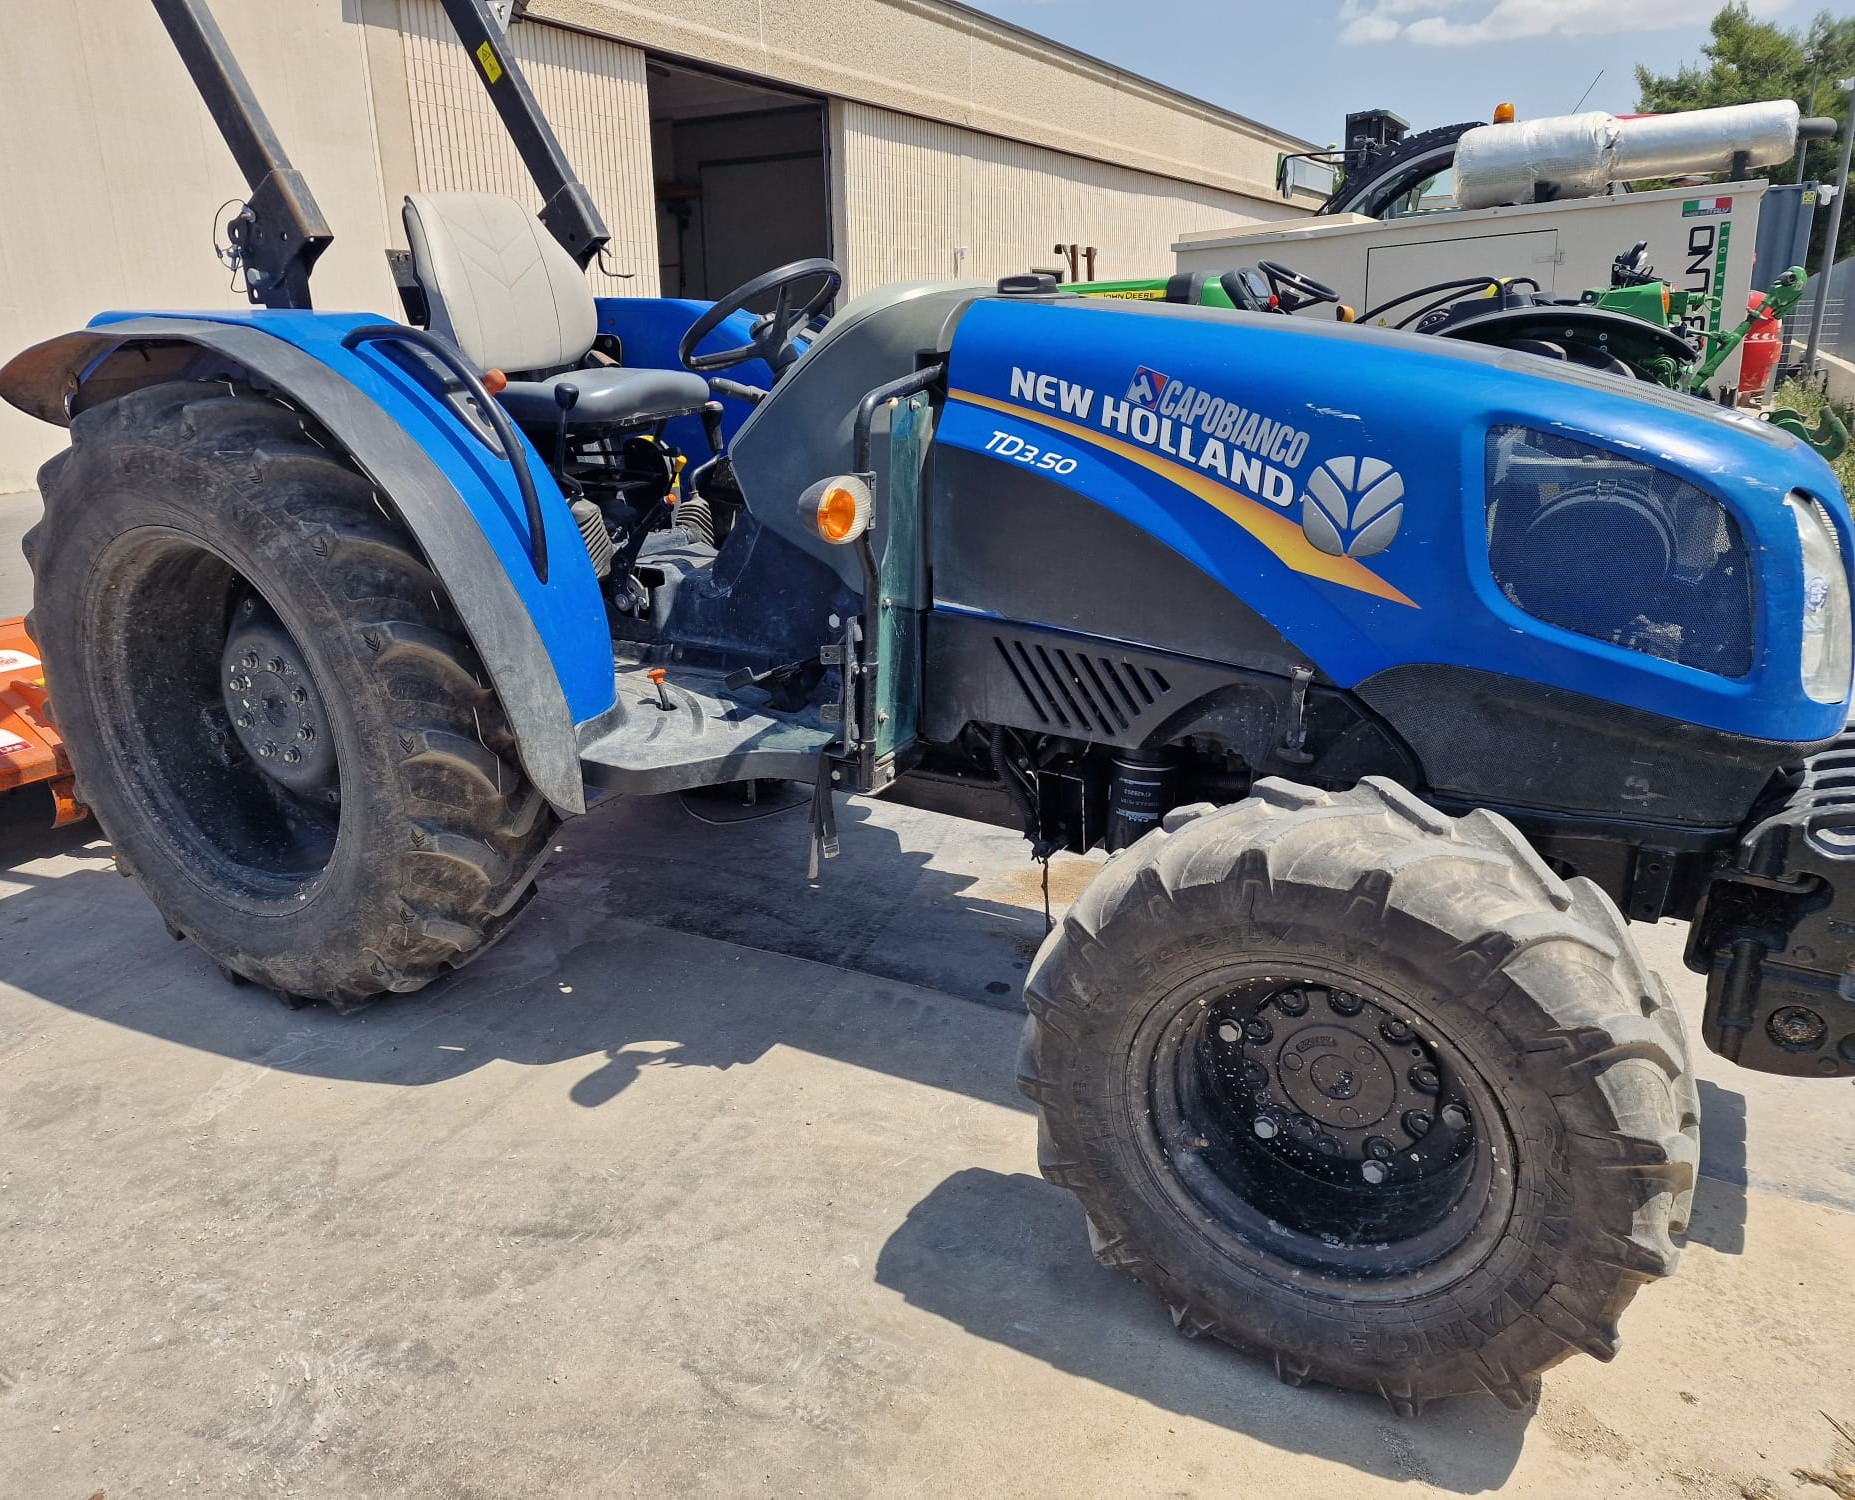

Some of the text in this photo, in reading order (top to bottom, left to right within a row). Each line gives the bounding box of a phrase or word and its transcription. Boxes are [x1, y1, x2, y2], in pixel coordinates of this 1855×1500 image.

[1125, 291, 1154, 300] DEERE
[984, 431, 1077, 475] TD3.50
[1009, 366, 1295, 508] NEW HOLLAND
[1159, 379, 1310, 469] CAPOBIANCO
